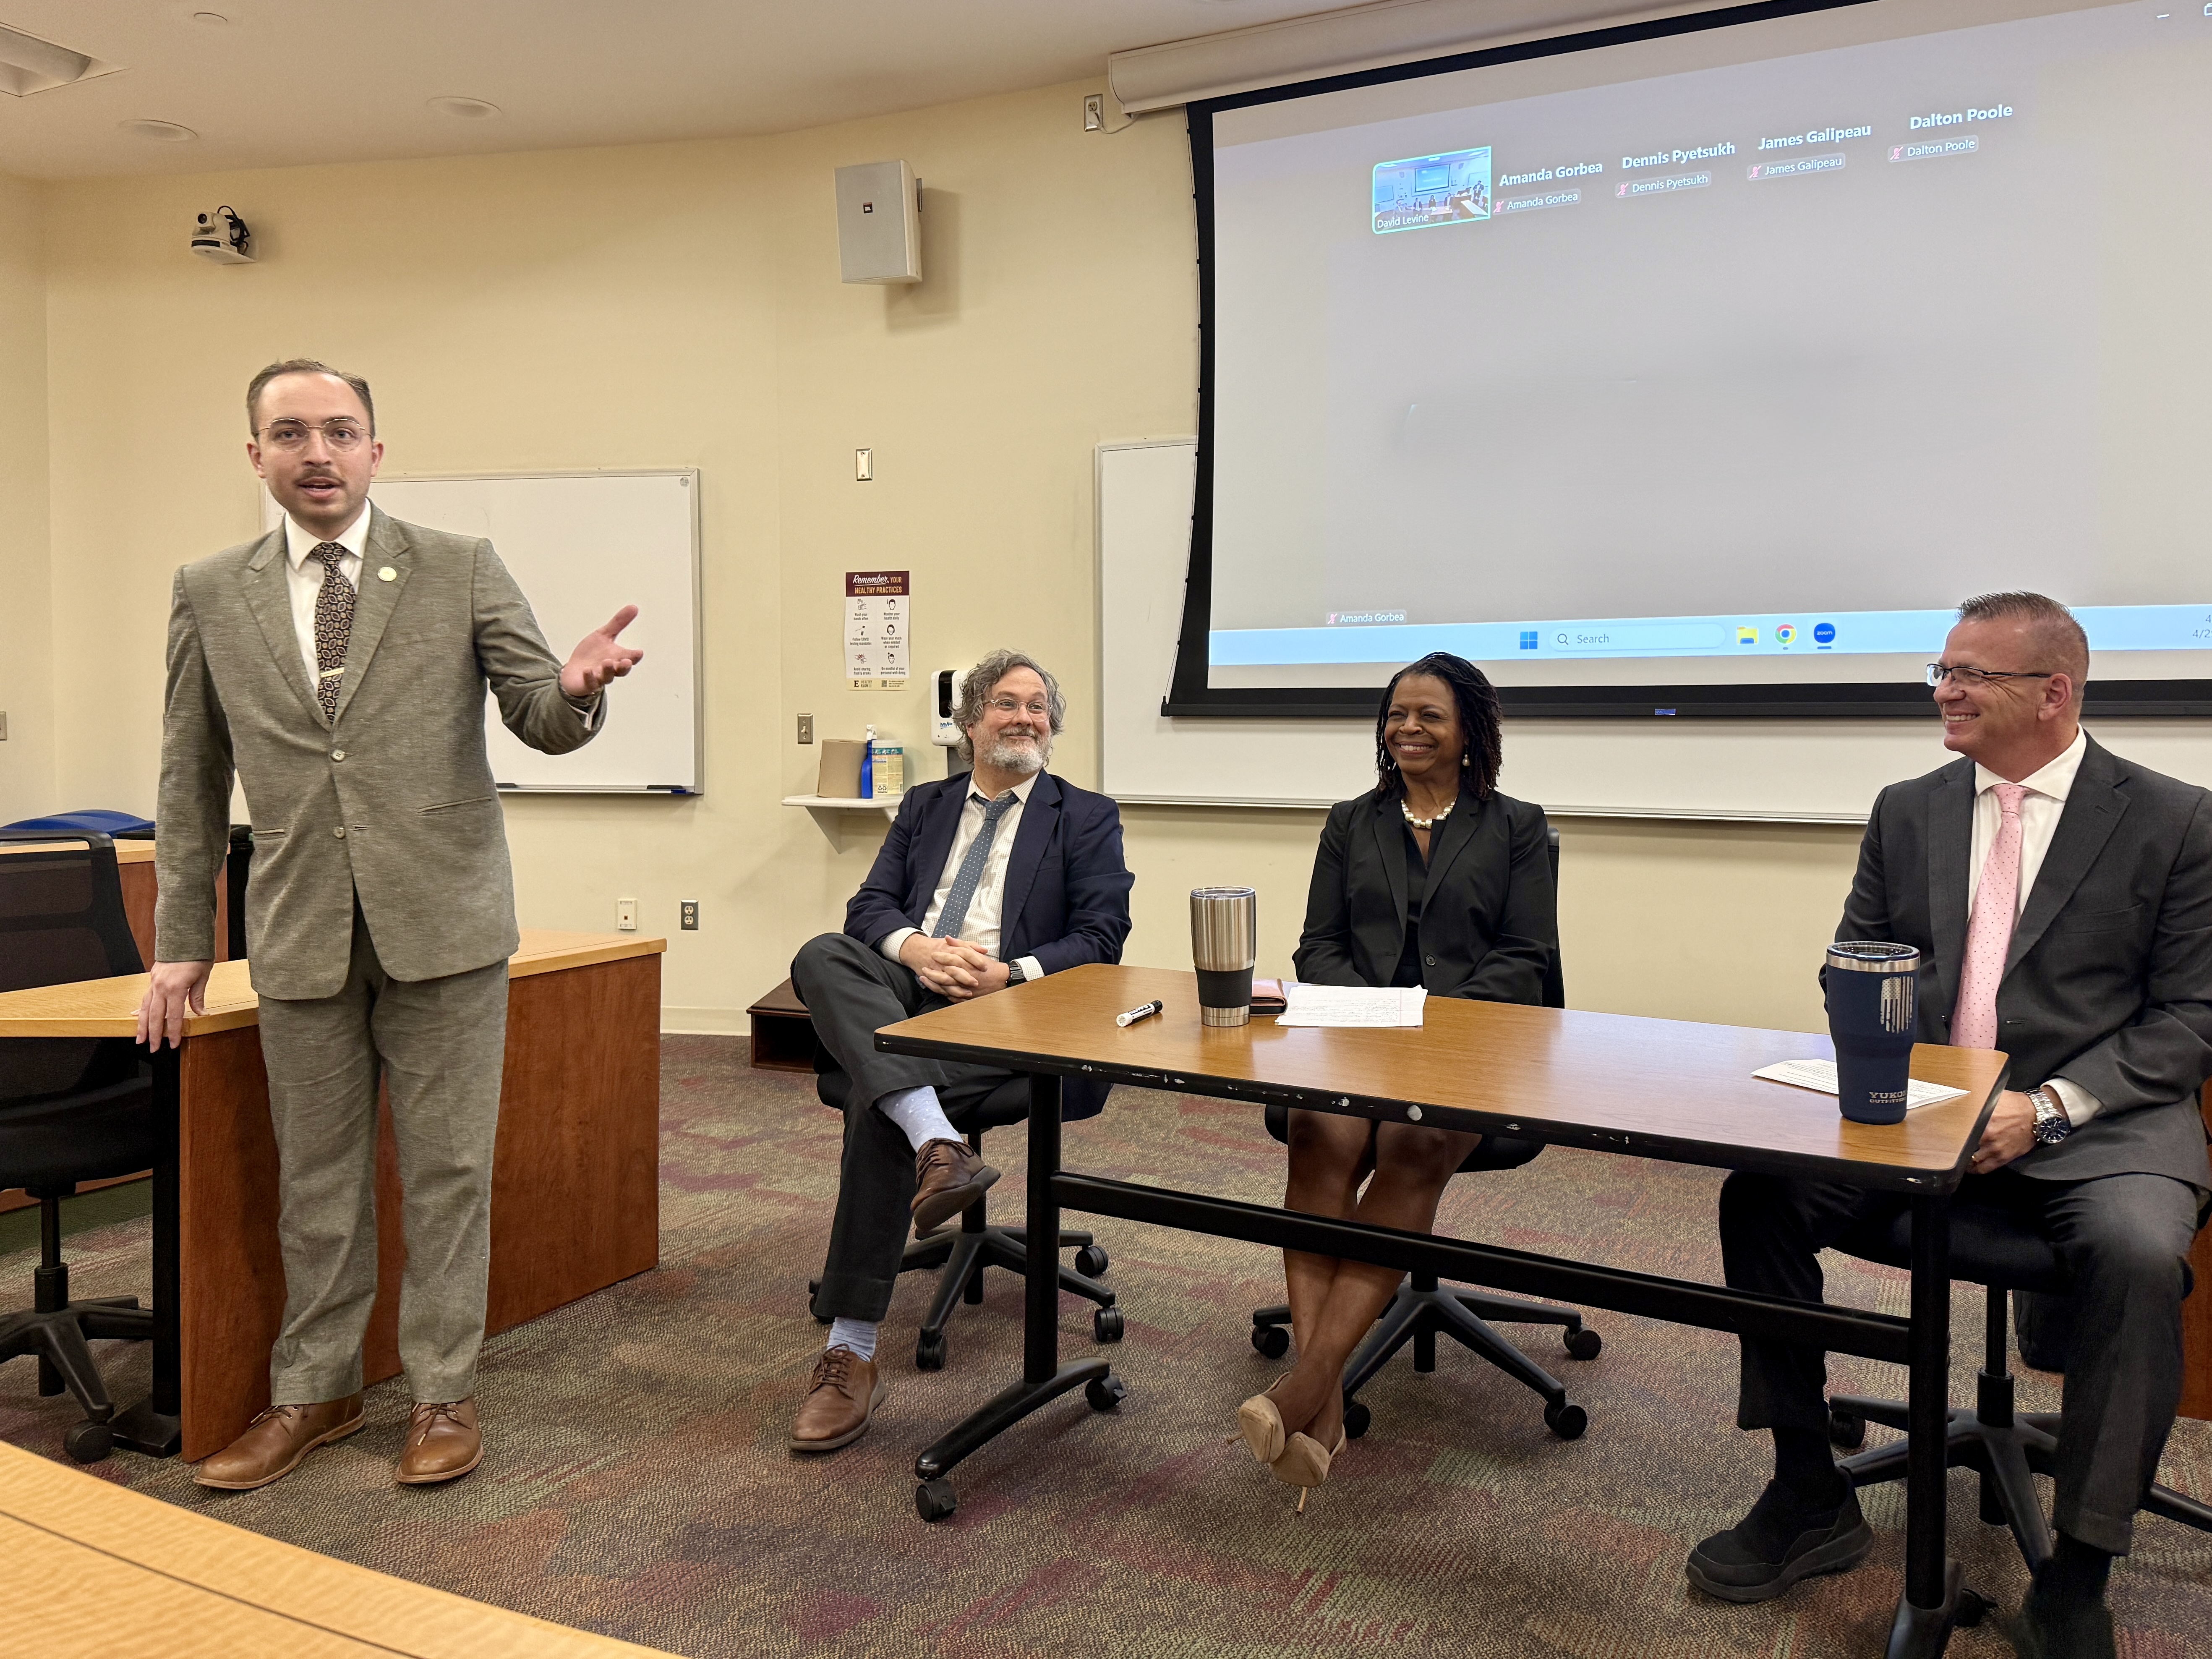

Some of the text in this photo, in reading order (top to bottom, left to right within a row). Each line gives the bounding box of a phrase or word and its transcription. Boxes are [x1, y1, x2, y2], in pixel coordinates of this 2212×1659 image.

[1910, 104, 2013, 129] Dalton Poole
[1758, 125, 1871, 150] James Galipeau
[1622, 142, 1735, 169] Dennis Pyetsukh
[1907, 139, 1975, 157] Dalton Poole
[1499, 163, 1603, 186] Amanda Gorbea
[1764, 157, 1842, 176] James Galipeau
[1632, 174, 1708, 193] Dennis Pyetsukh
[1507, 192, 1578, 210] Amanda Gorbea
[1377, 214, 1429, 229] David Levine
[1340, 612, 1404, 623] Amanda Gorbea
[1577, 634, 1609, 643] Search
[2192, 629, 2212, 638] 4/2
